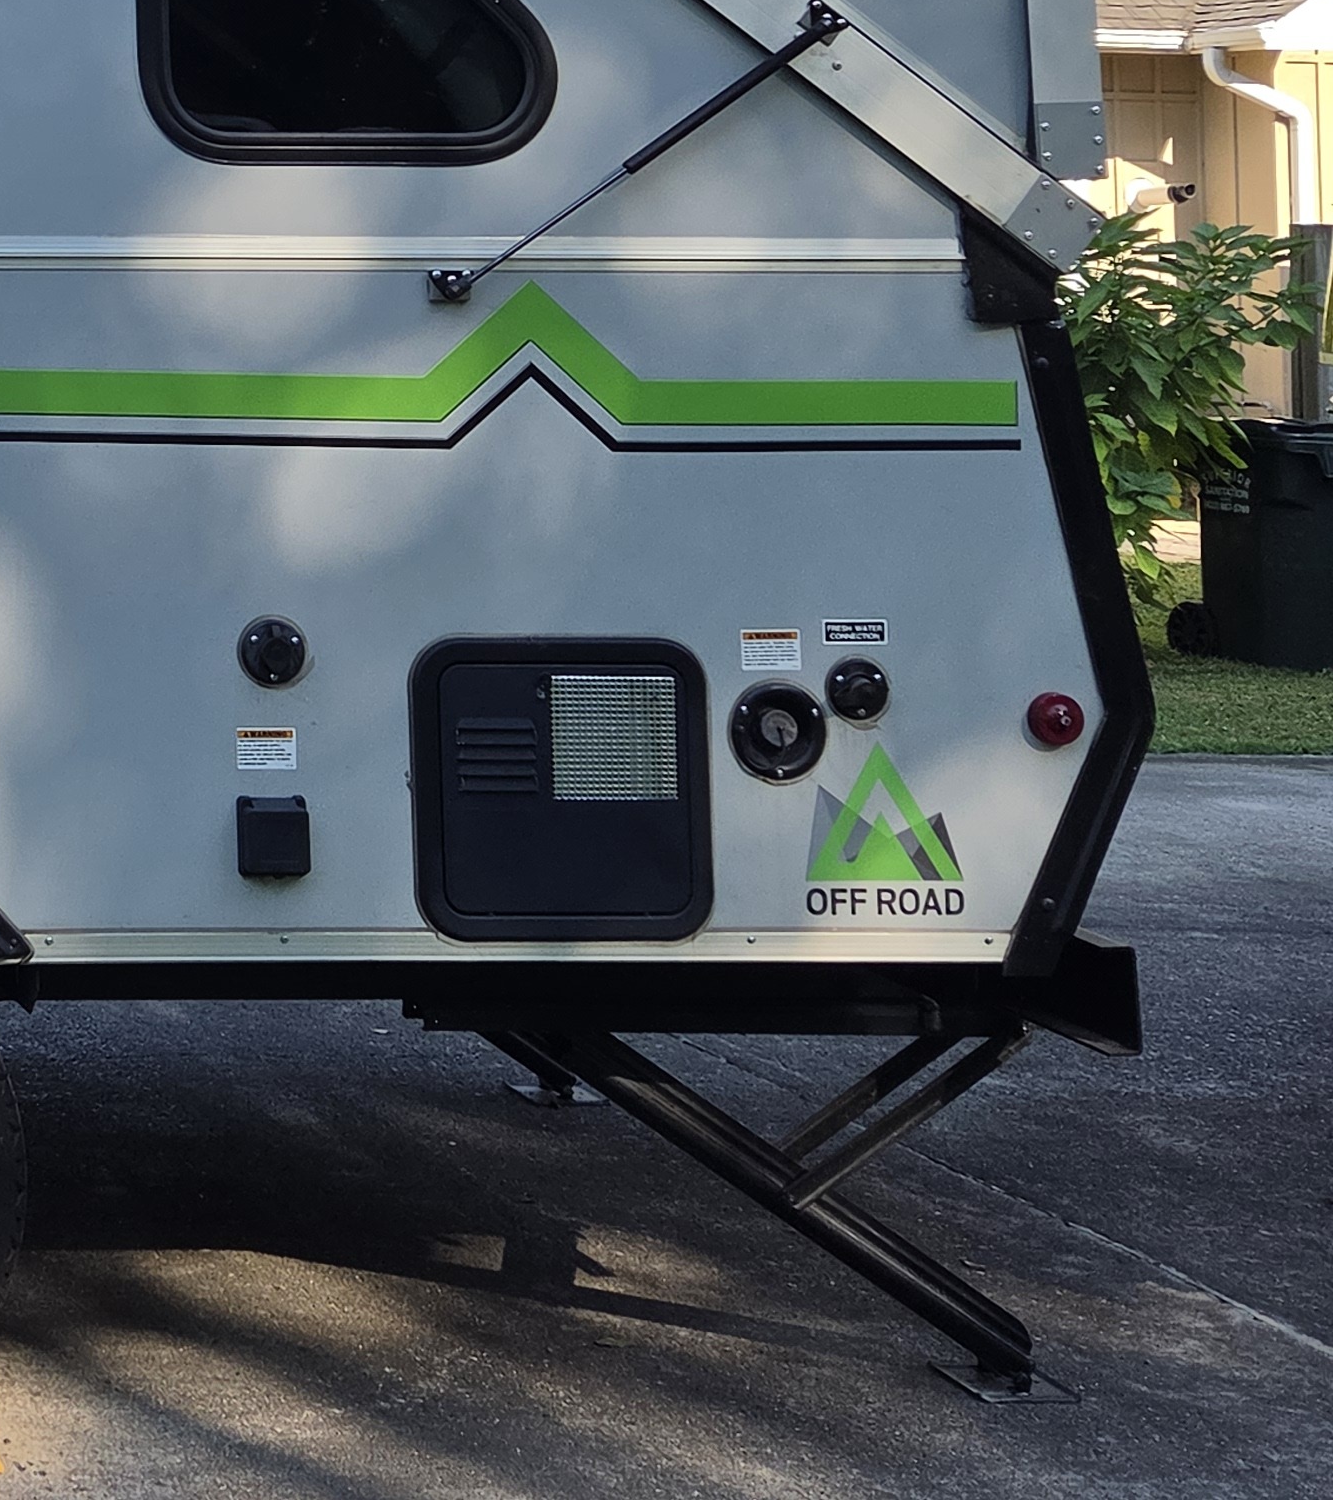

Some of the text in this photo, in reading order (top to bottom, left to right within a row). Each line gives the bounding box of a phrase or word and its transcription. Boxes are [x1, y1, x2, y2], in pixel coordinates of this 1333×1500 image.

[827, 624, 883, 632] FRESH WATER
[829, 632, 881, 640] CONNECTION
[806, 887, 965, 916] OFF ROAD
